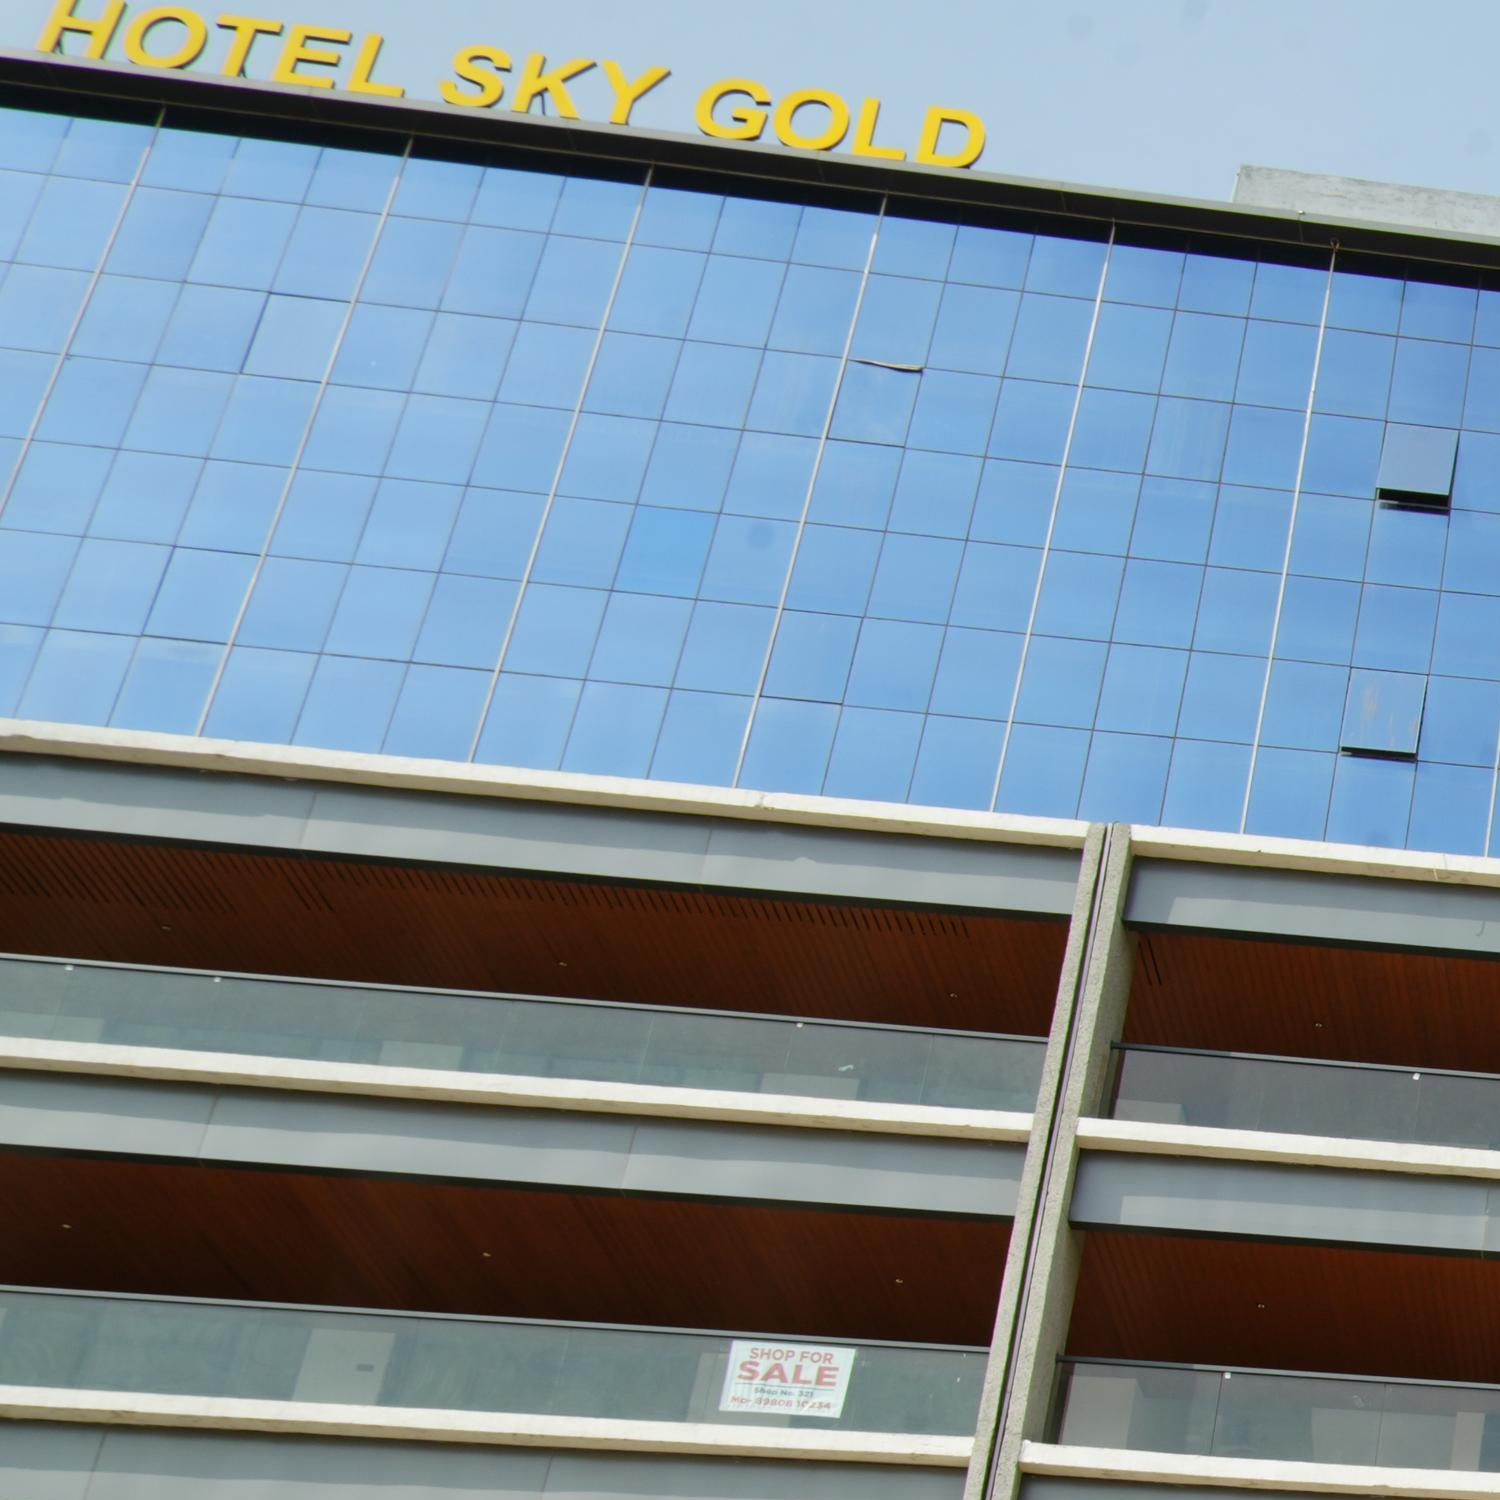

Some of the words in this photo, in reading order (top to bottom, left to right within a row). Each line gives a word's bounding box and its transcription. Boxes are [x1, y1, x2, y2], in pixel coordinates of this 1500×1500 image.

[37, 0, 405, 99] HOTEL
[440, 44, 671, 125] SKY
[695, 77, 986, 170] GOLD
[749, 1347, 796, 1361] SHOP
[800, 1351, 835, 1365] FOR
[736, 1360, 840, 1387] SALE
